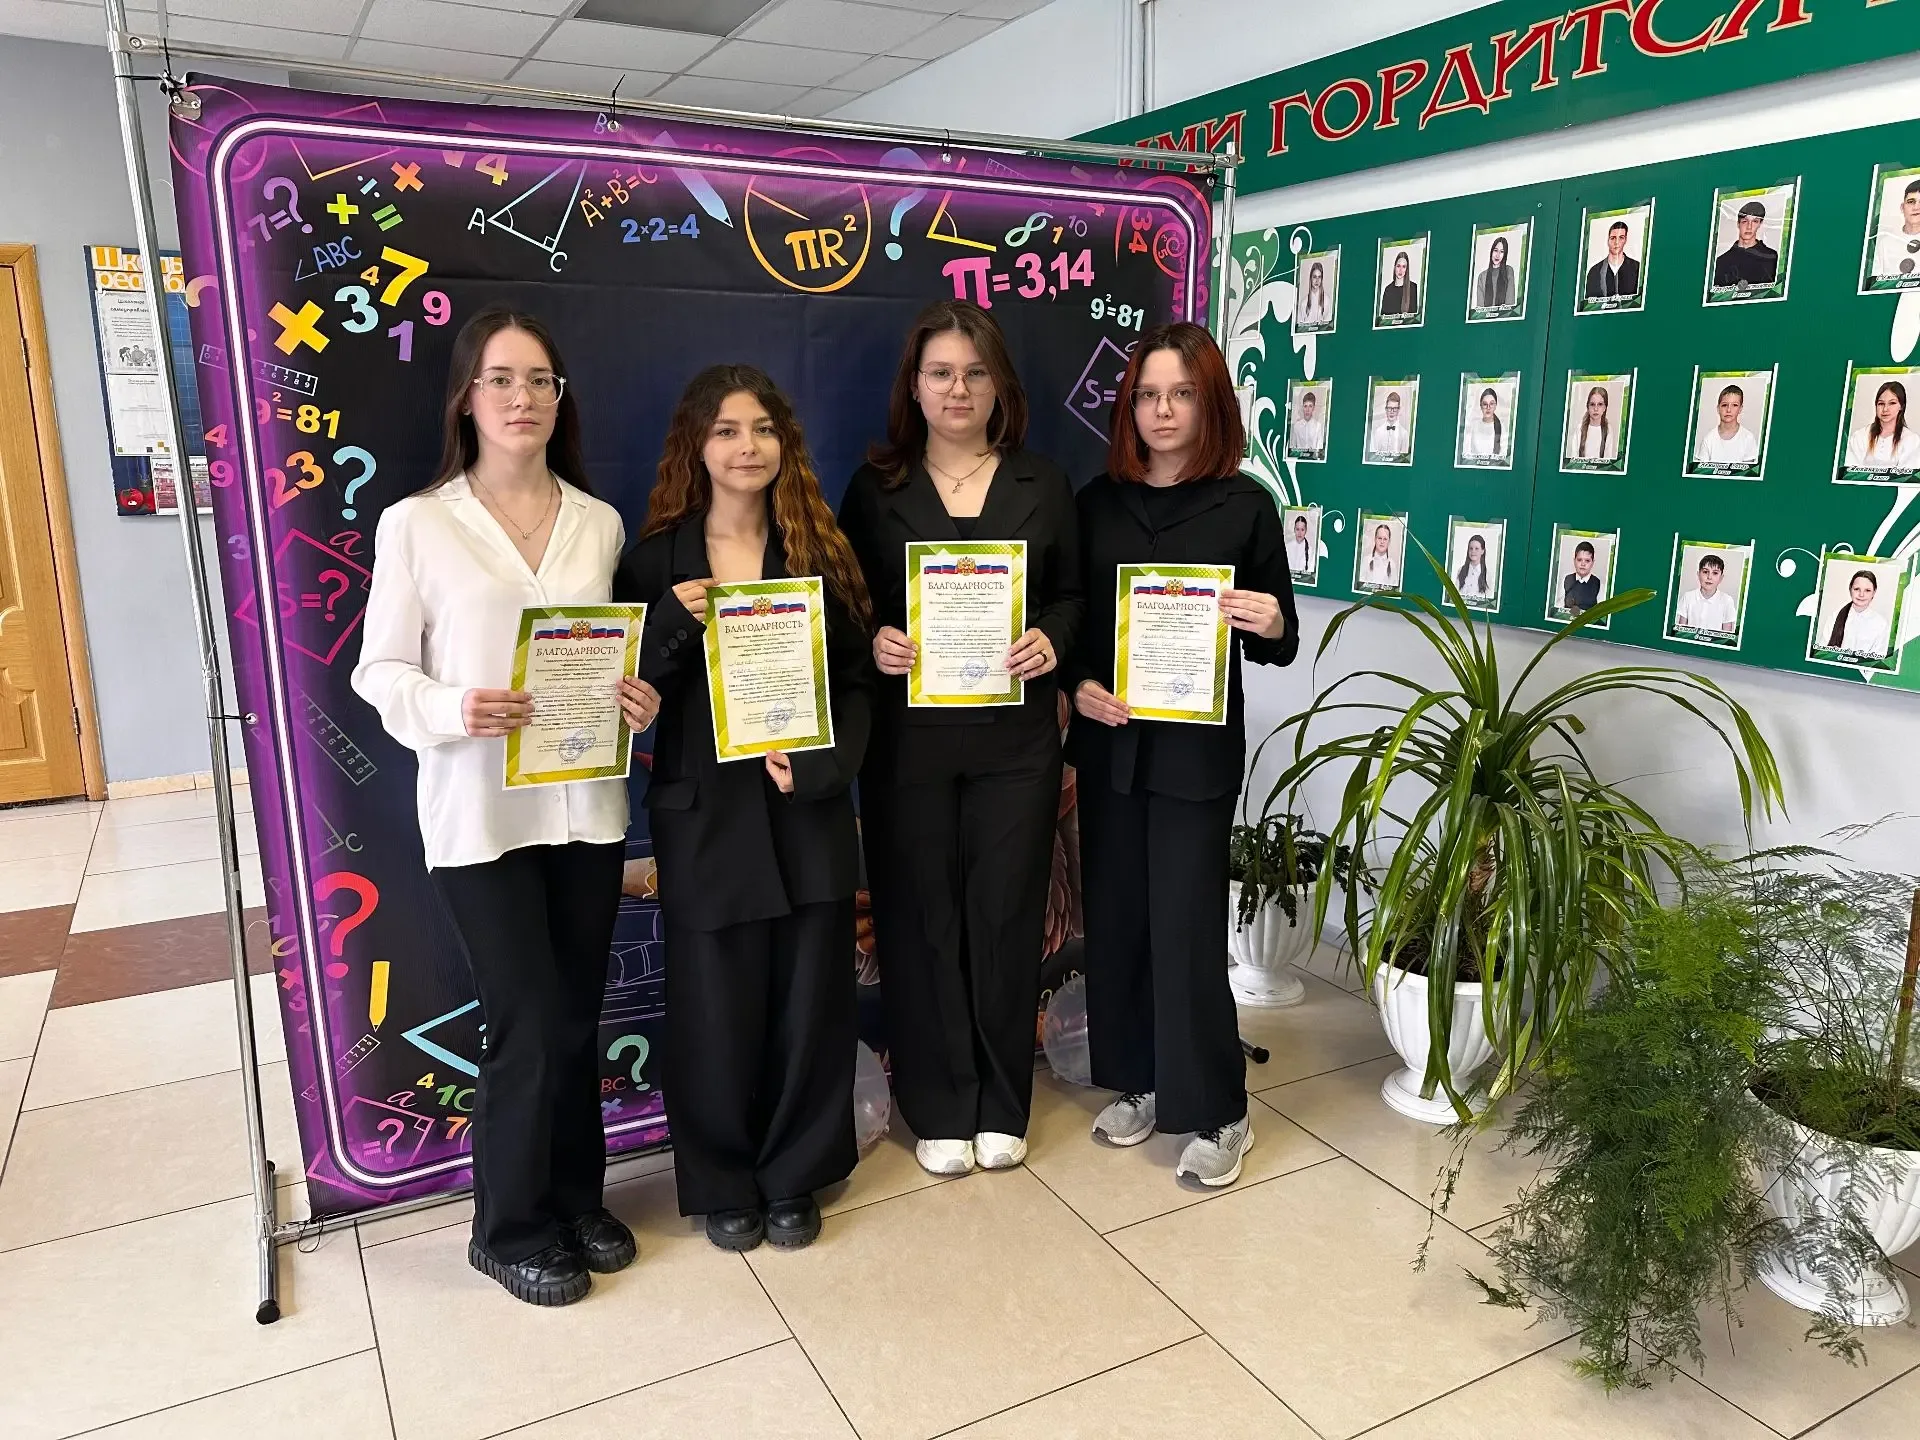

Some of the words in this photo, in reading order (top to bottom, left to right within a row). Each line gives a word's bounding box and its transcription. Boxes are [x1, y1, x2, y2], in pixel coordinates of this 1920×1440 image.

[467, 207, 485, 235] A
[550, 251, 568, 273] C
[360, 265, 380, 287] 4
[379, 245, 430, 307] 7
[334, 285, 379, 334] 3
[422, 290, 451, 326] 9
[387, 319, 414, 362] 1
[1082, 371, 1126, 409] S=
[925, 581, 1005, 591] БЛАГОДАРНОСТЬ
[1137, 601, 1211, 612] БЛАГОДАРНОСТЬ
[725, 620, 804, 634] БЛАГОДАРНОСТЬ
[535, 646, 619, 657] БЛАГОДАРНОСТЬ
[416, 1072, 435, 1089] 4
[445, 1116, 468, 1140] 7
